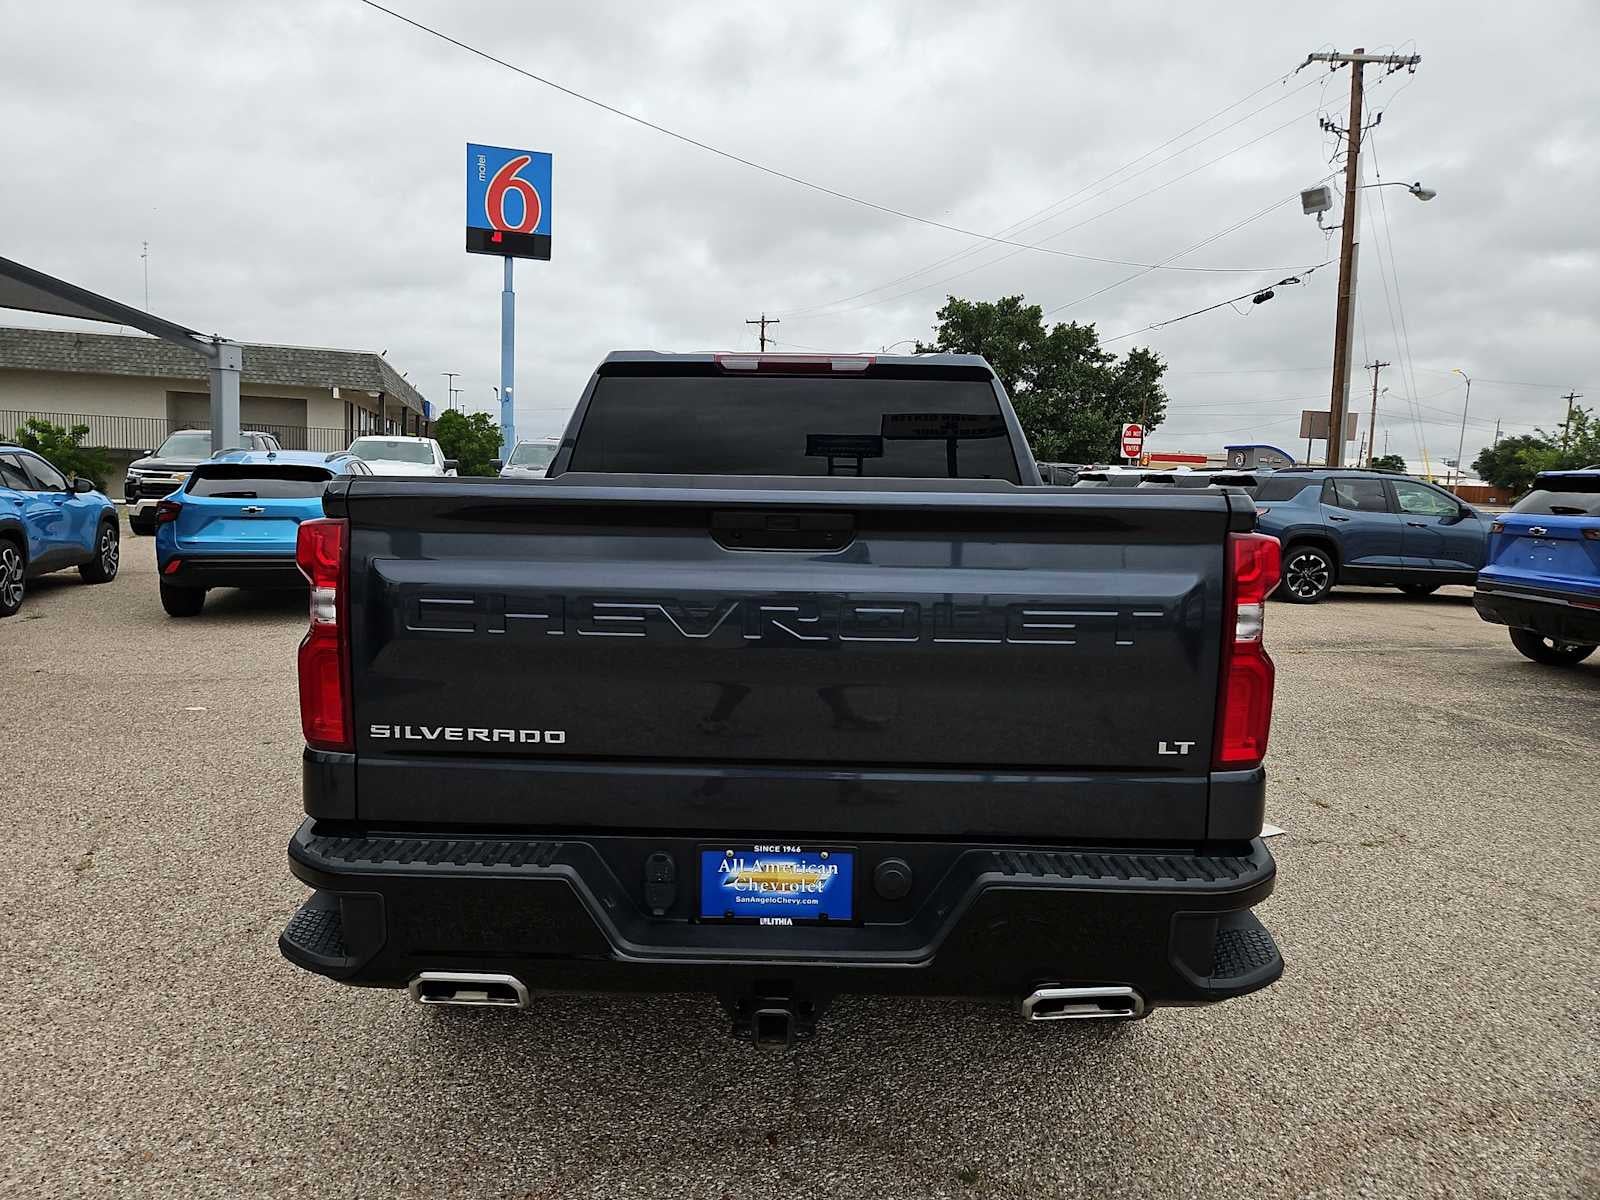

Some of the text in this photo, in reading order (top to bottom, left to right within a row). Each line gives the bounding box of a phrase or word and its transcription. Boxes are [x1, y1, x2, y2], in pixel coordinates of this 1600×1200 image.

[477, 154, 486, 181] motel
[485, 155, 542, 234] 6
[405, 592, 1165, 645] CHEVROLET
[369, 724, 567, 744] SILVERADO
[1157, 740, 1196, 756] LT
[782, 845, 802, 853] 1946
[718, 858, 839, 875] All American
[735, 876, 825, 893] Chevrolet
[735, 895, 819, 905] SanAngeloChevy.com
[767, 917, 793, 926] LITHIA
